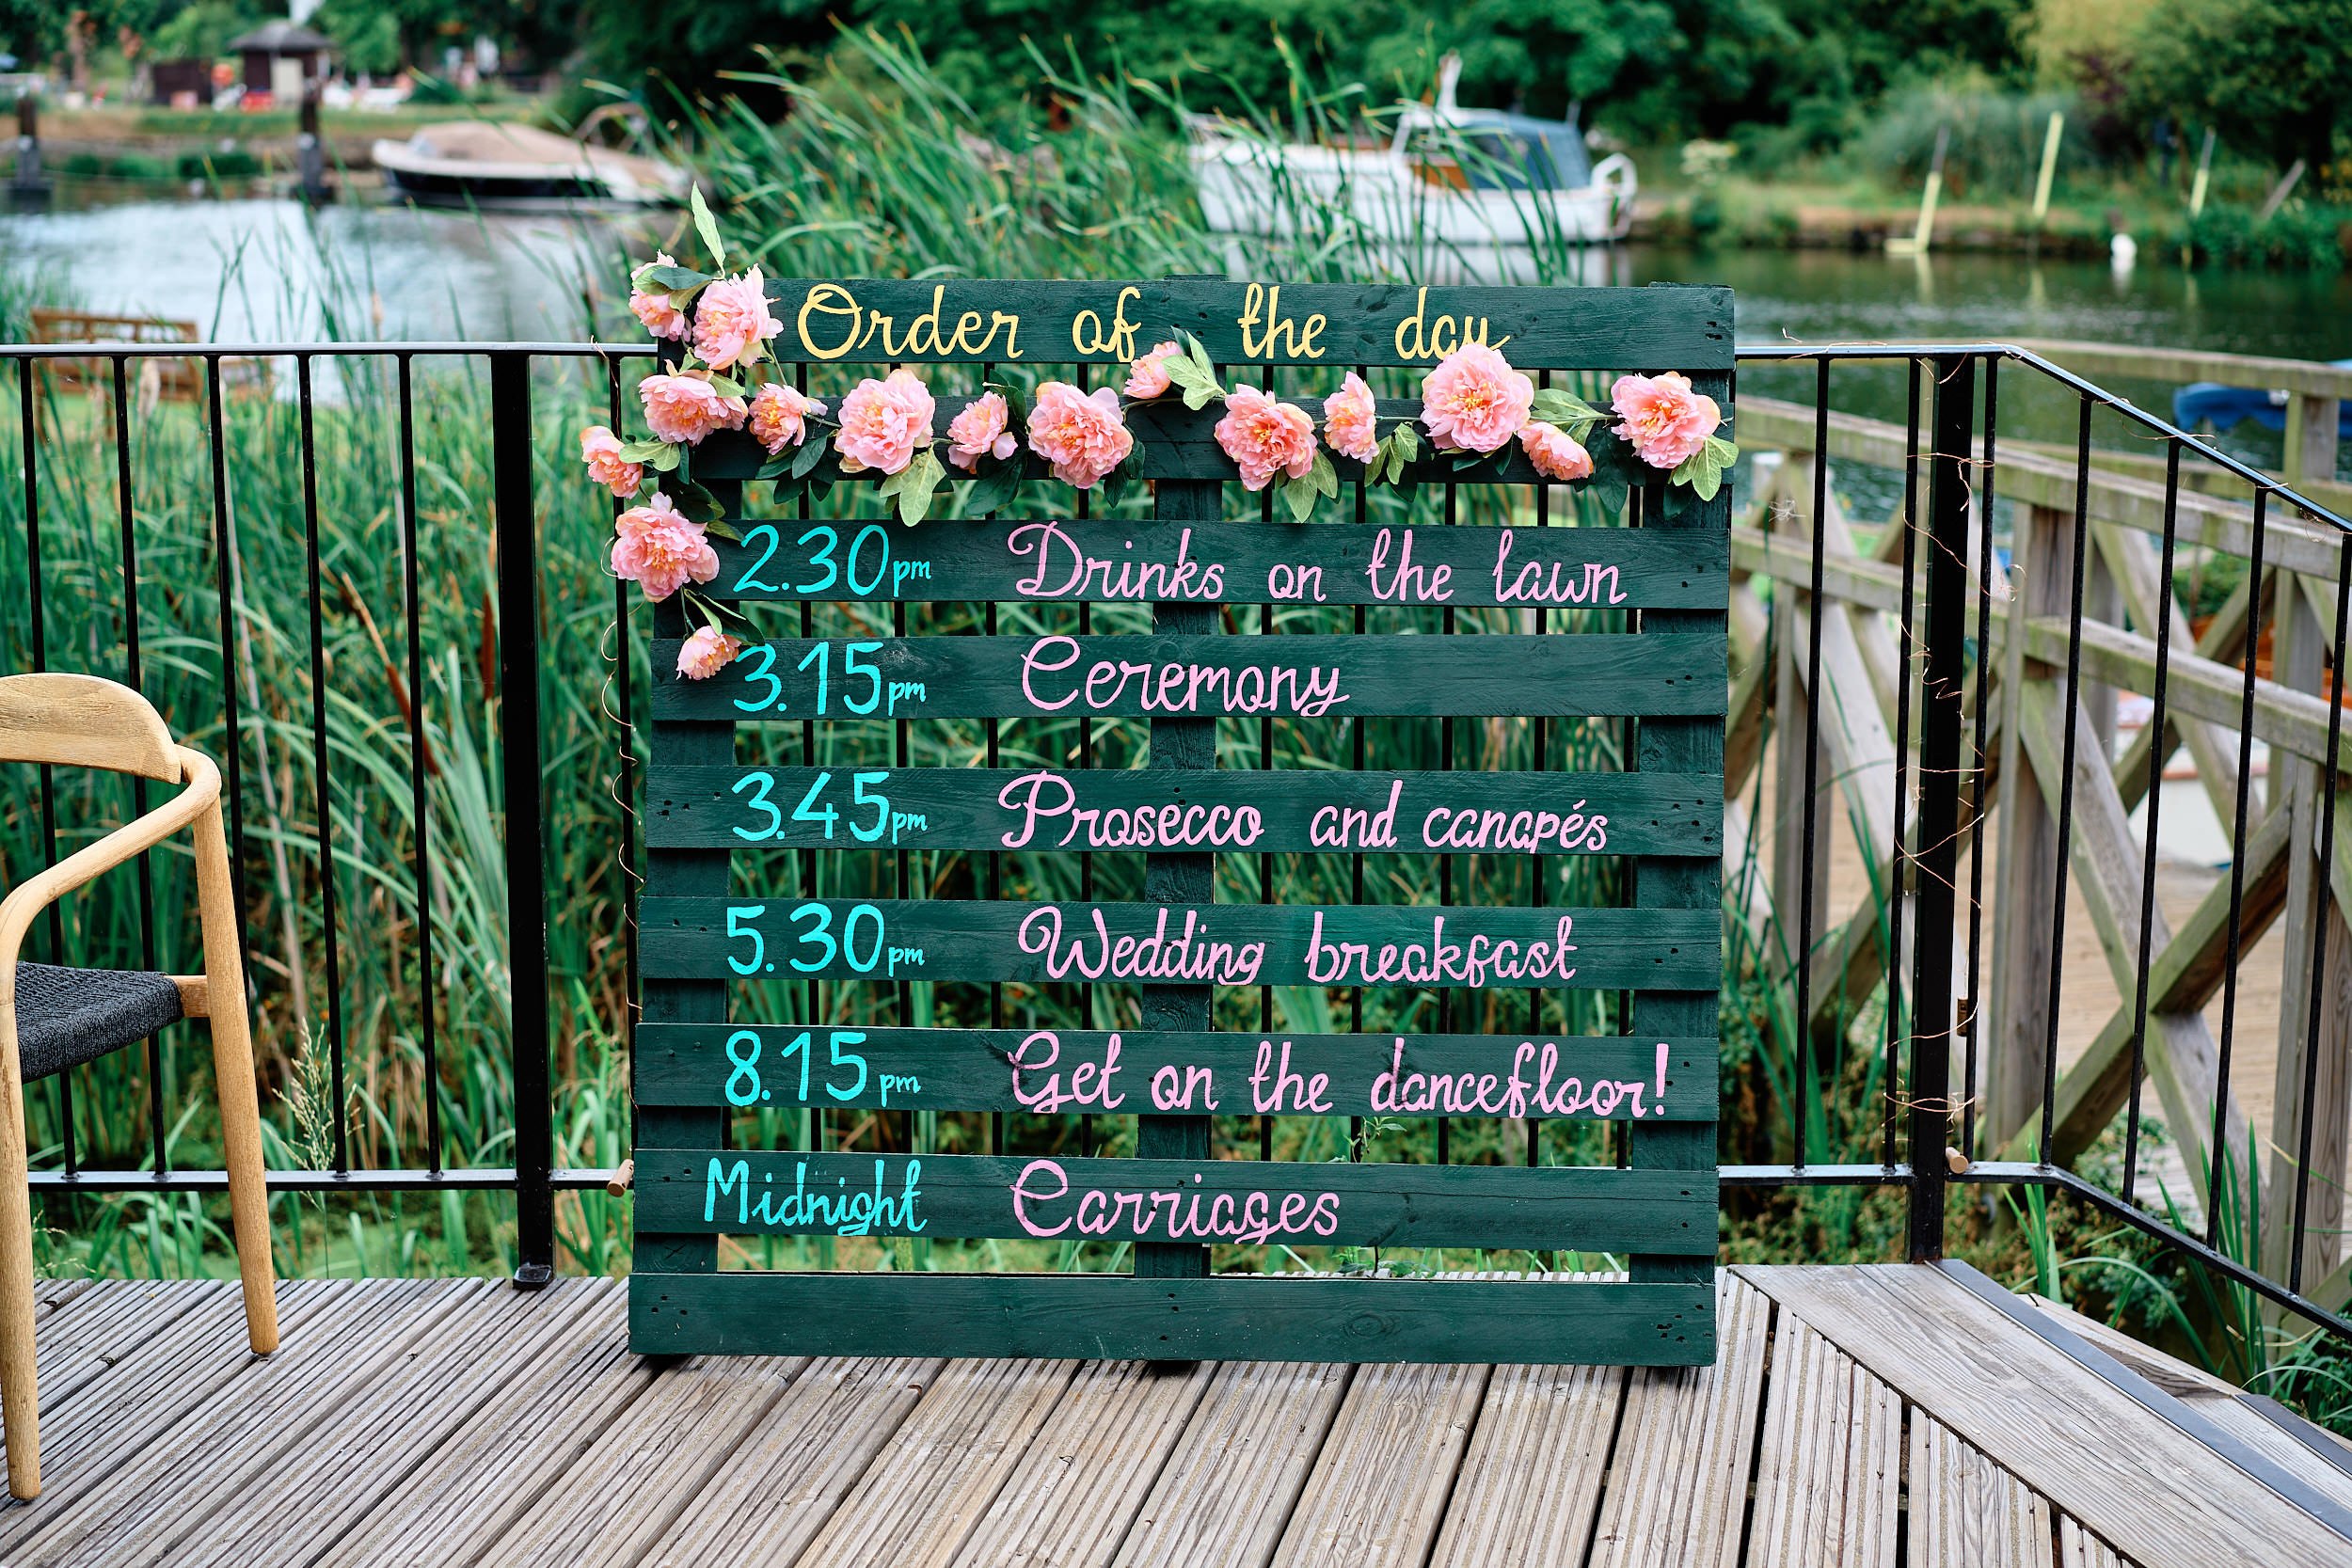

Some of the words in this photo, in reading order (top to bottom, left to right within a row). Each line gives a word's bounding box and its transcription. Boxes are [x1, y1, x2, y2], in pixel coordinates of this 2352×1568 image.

[797, 283, 1025, 359] Order
[1072, 286, 1142, 363] of
[1237, 282, 1327, 359] the
[1008, 520, 1225, 599] Drinks
[1268, 563, 1326, 602] on
[1366, 528, 1454, 601] the
[1493, 529, 1628, 605] lawn
[1022, 635, 1349, 717] Ceremony
[998, 770, 1264, 848] Prosecco
[1310, 779, 1403, 847] and
[1422, 800, 1609, 854] canapés
[1018, 906, 1265, 986] Wedding
[1304, 911, 1577, 988] breakfast
[1009, 1031, 1125, 1114] Get
[1151, 1065, 1219, 1112] on
[1249, 1041, 1333, 1113] the
[1370, 1037, 1669, 1119] dancefloor!
[704, 1157, 928, 1237] Midnight
[1010, 1159, 1340, 1245] Carriages
